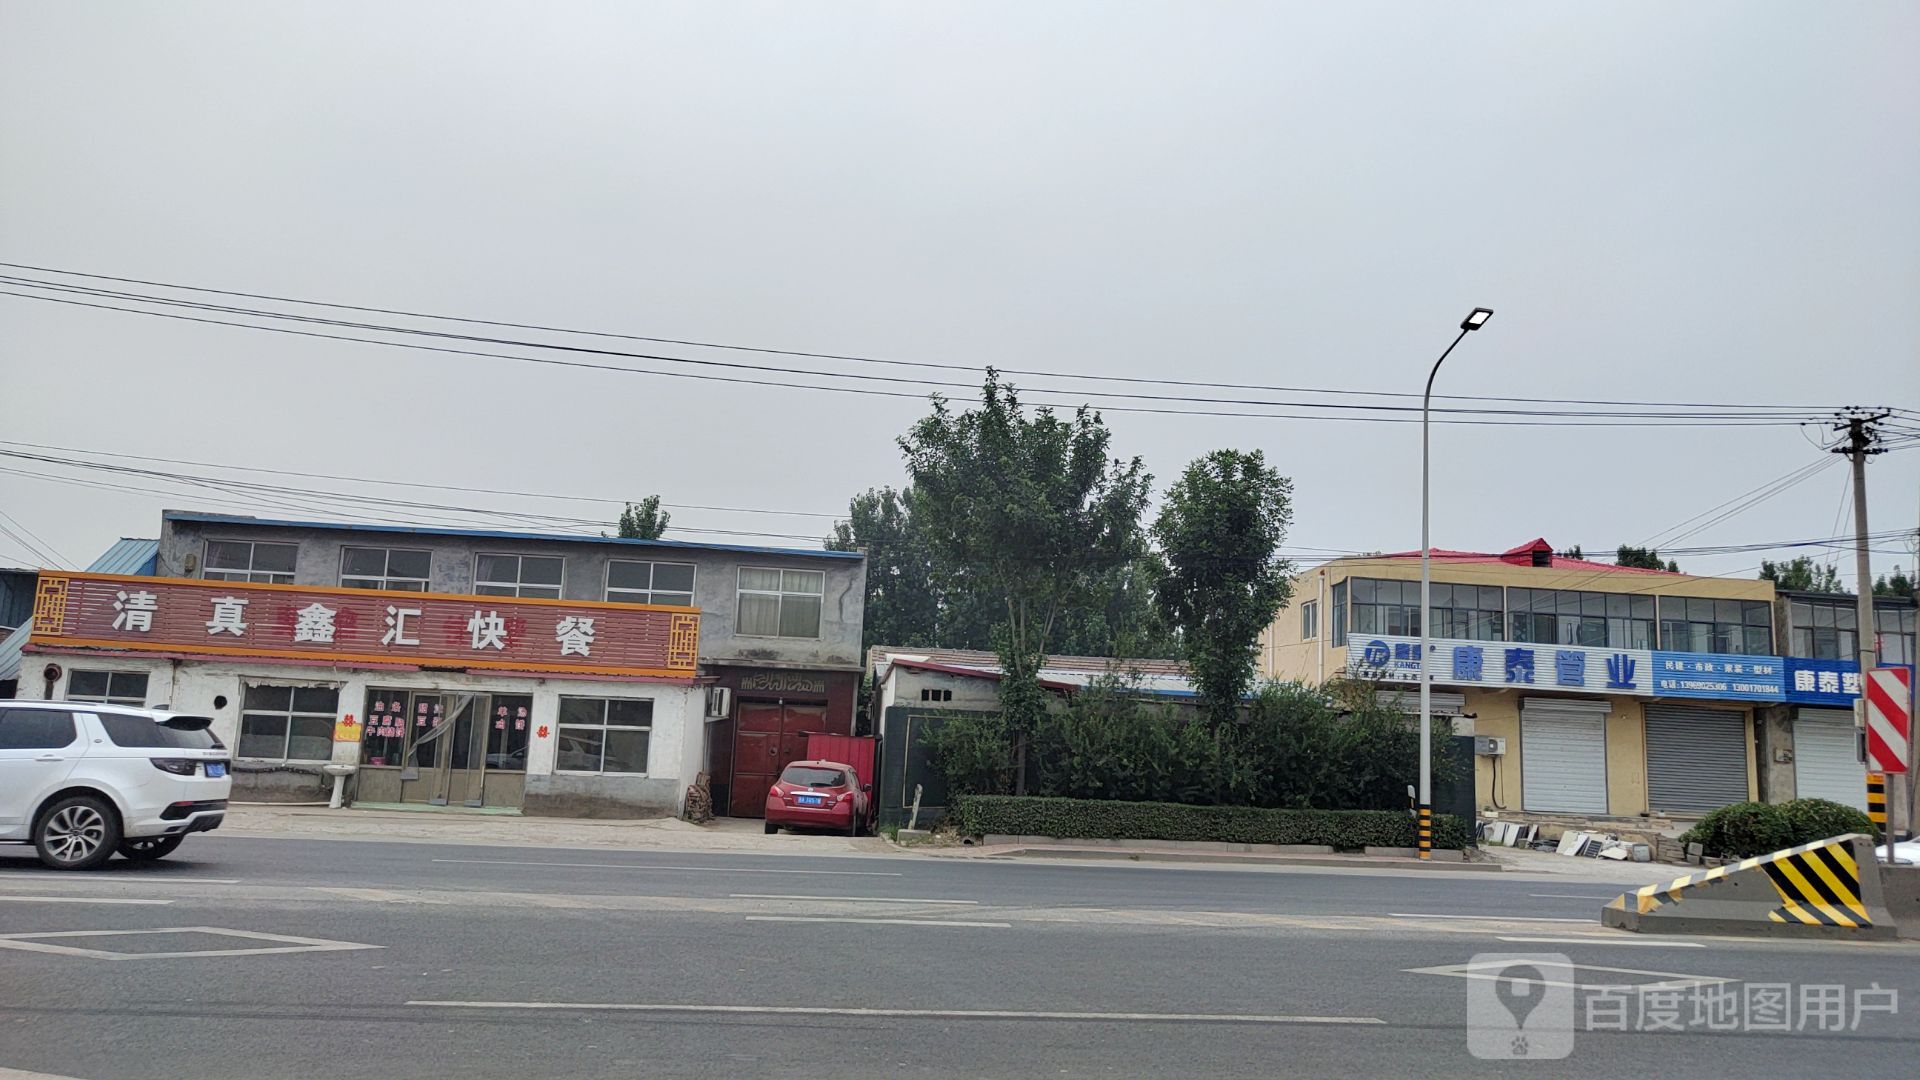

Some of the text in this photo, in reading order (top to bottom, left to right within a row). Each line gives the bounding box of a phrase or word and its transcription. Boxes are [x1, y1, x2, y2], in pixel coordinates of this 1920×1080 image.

[111, 590, 596, 657] 清真鑫汇快餐
[1453, 645, 1637, 690] 康泰管业
[1794, 670, 1861, 694] 康泰塑
